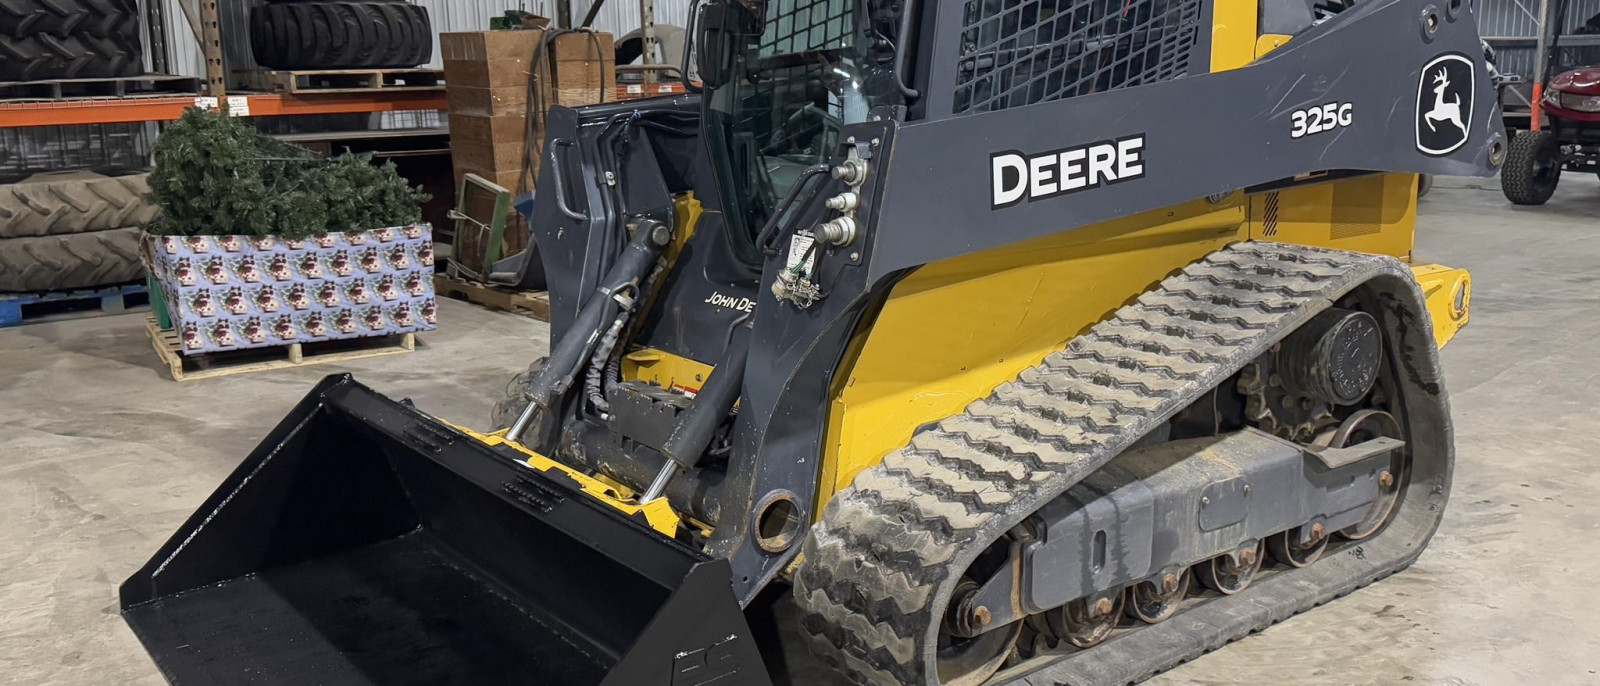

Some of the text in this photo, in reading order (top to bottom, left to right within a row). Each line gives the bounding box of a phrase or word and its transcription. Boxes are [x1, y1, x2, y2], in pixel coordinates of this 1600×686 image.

[1291, 102, 1353, 138] 325G
[992, 137, 1144, 206] DEERE
[704, 291, 739, 309] JOHN
